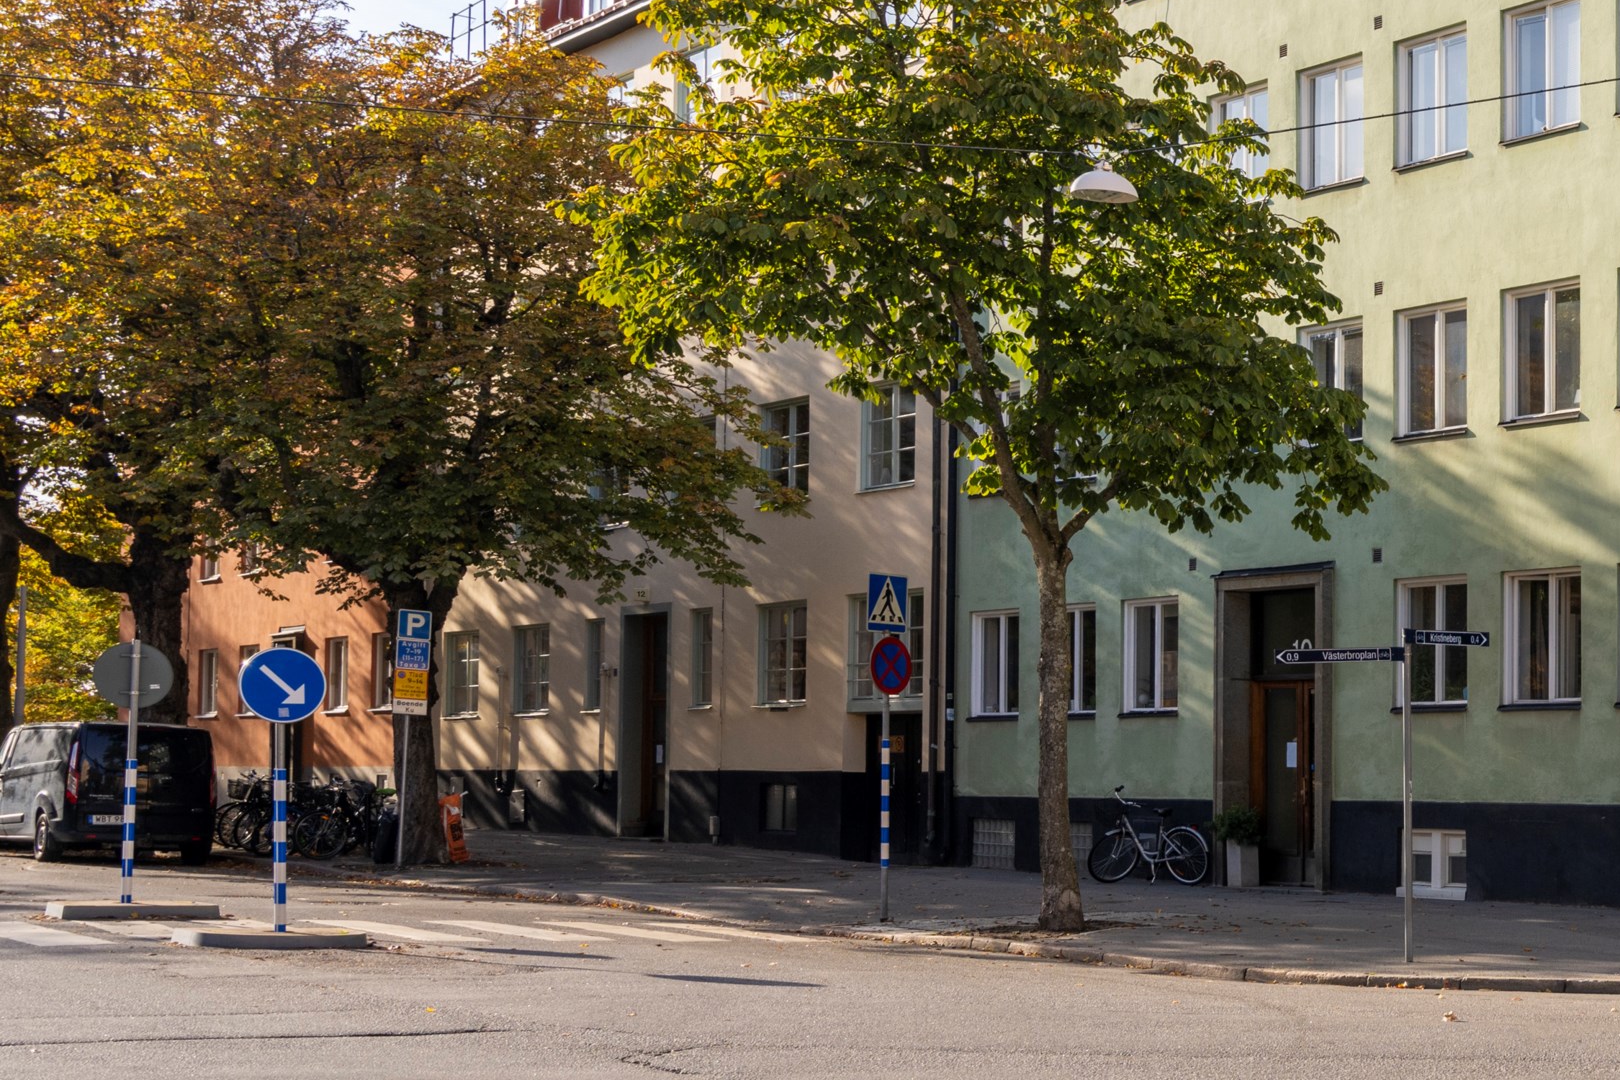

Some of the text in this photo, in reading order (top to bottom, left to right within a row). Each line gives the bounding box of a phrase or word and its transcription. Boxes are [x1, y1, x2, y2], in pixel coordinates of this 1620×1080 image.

[407, 613, 426, 636] P
[1430, 632, 1479, 645] Kristineberg 0,4
[1323, 651, 1376, 662] Västerbroplan
